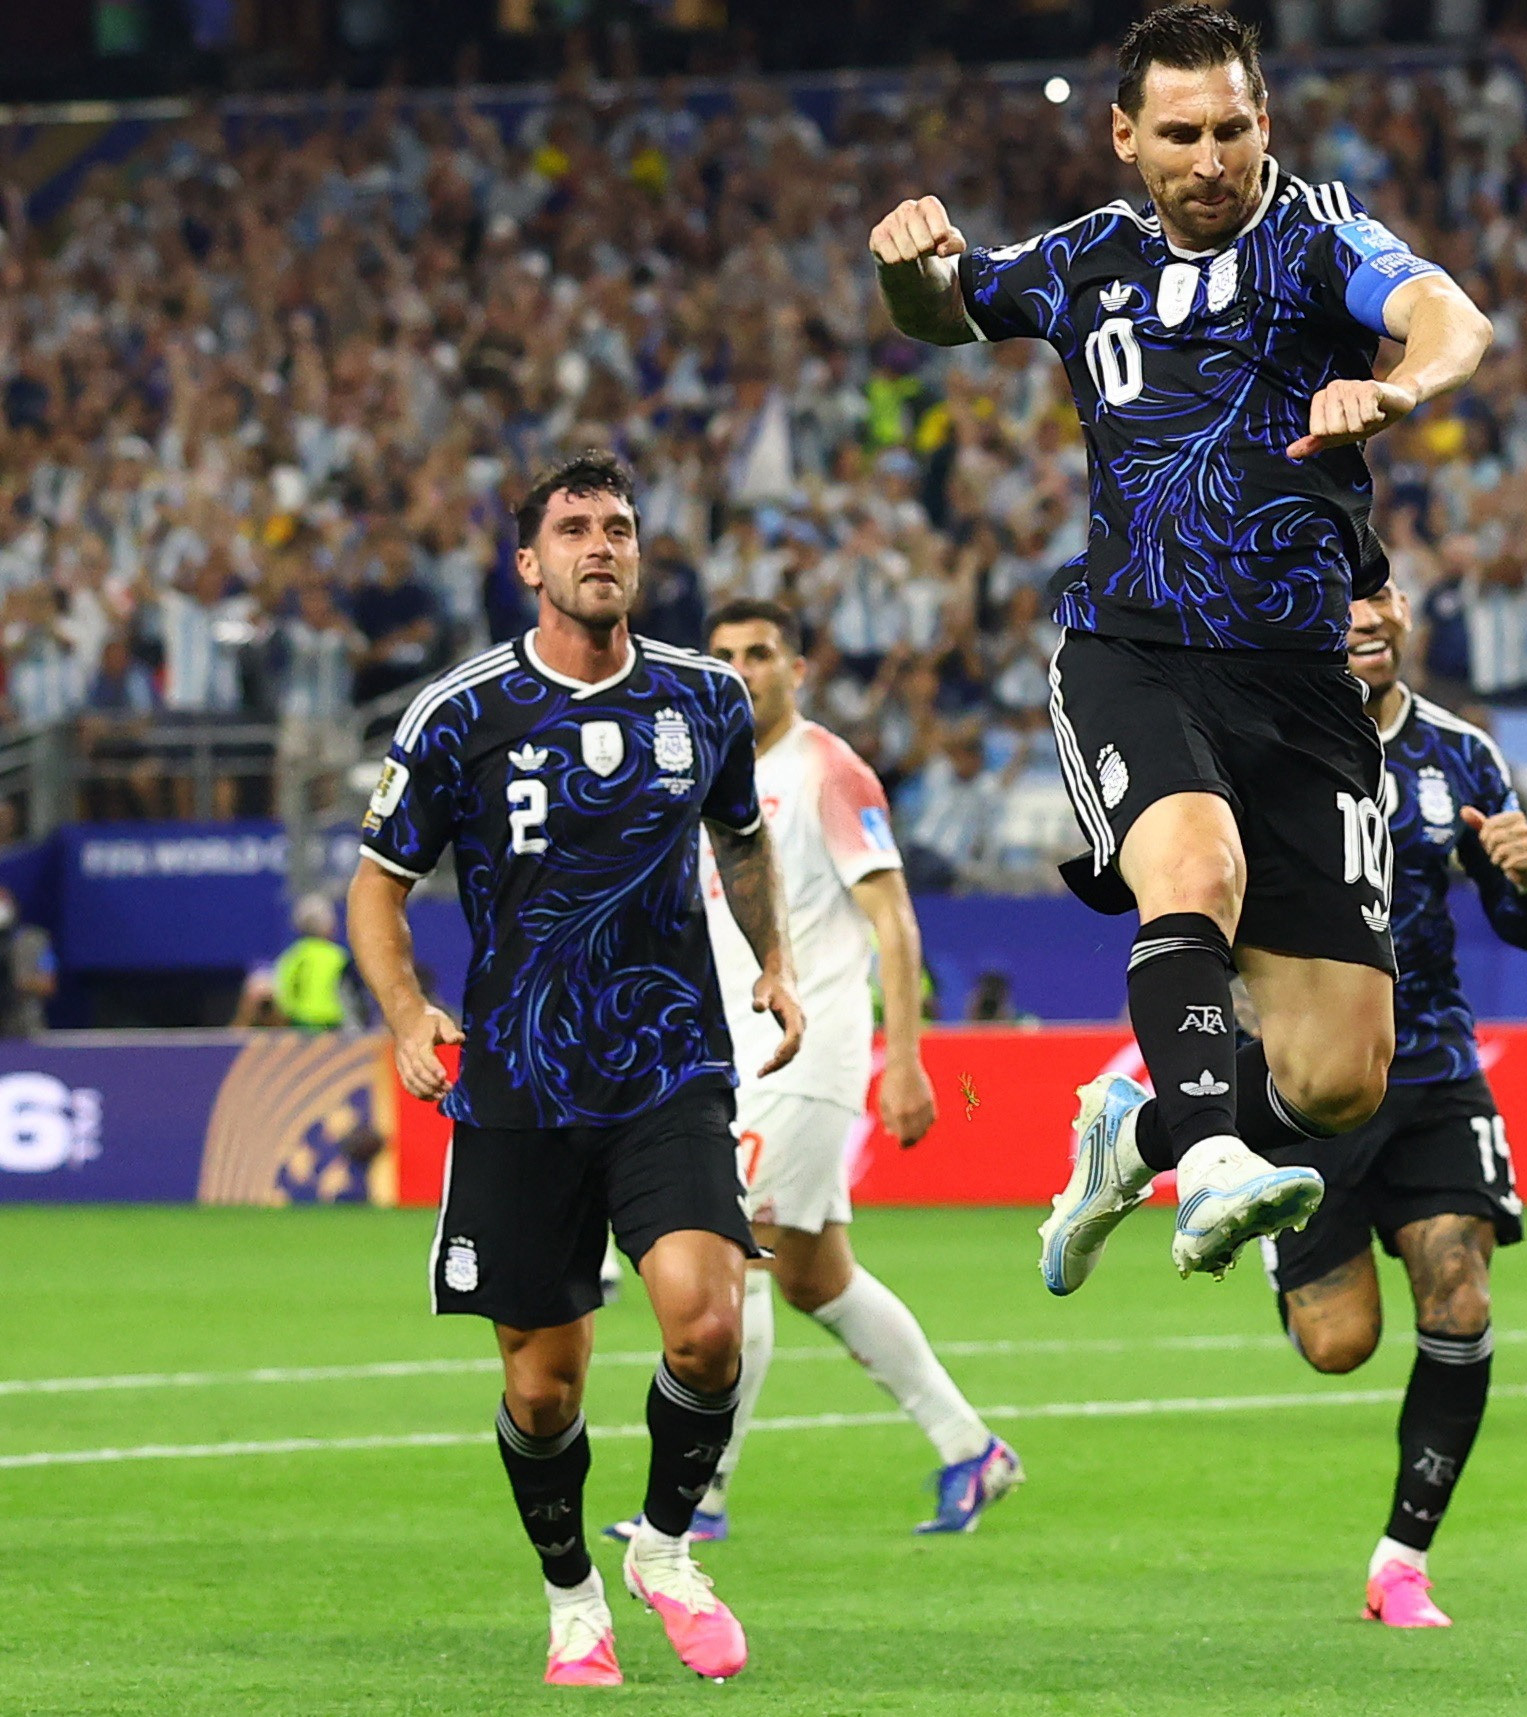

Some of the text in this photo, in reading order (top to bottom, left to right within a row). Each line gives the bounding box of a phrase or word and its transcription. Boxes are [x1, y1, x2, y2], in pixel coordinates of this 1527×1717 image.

[1085, 318, 1143, 413] 10
[507, 780, 547, 854] 2
[1337, 792, 1384, 891] 10
